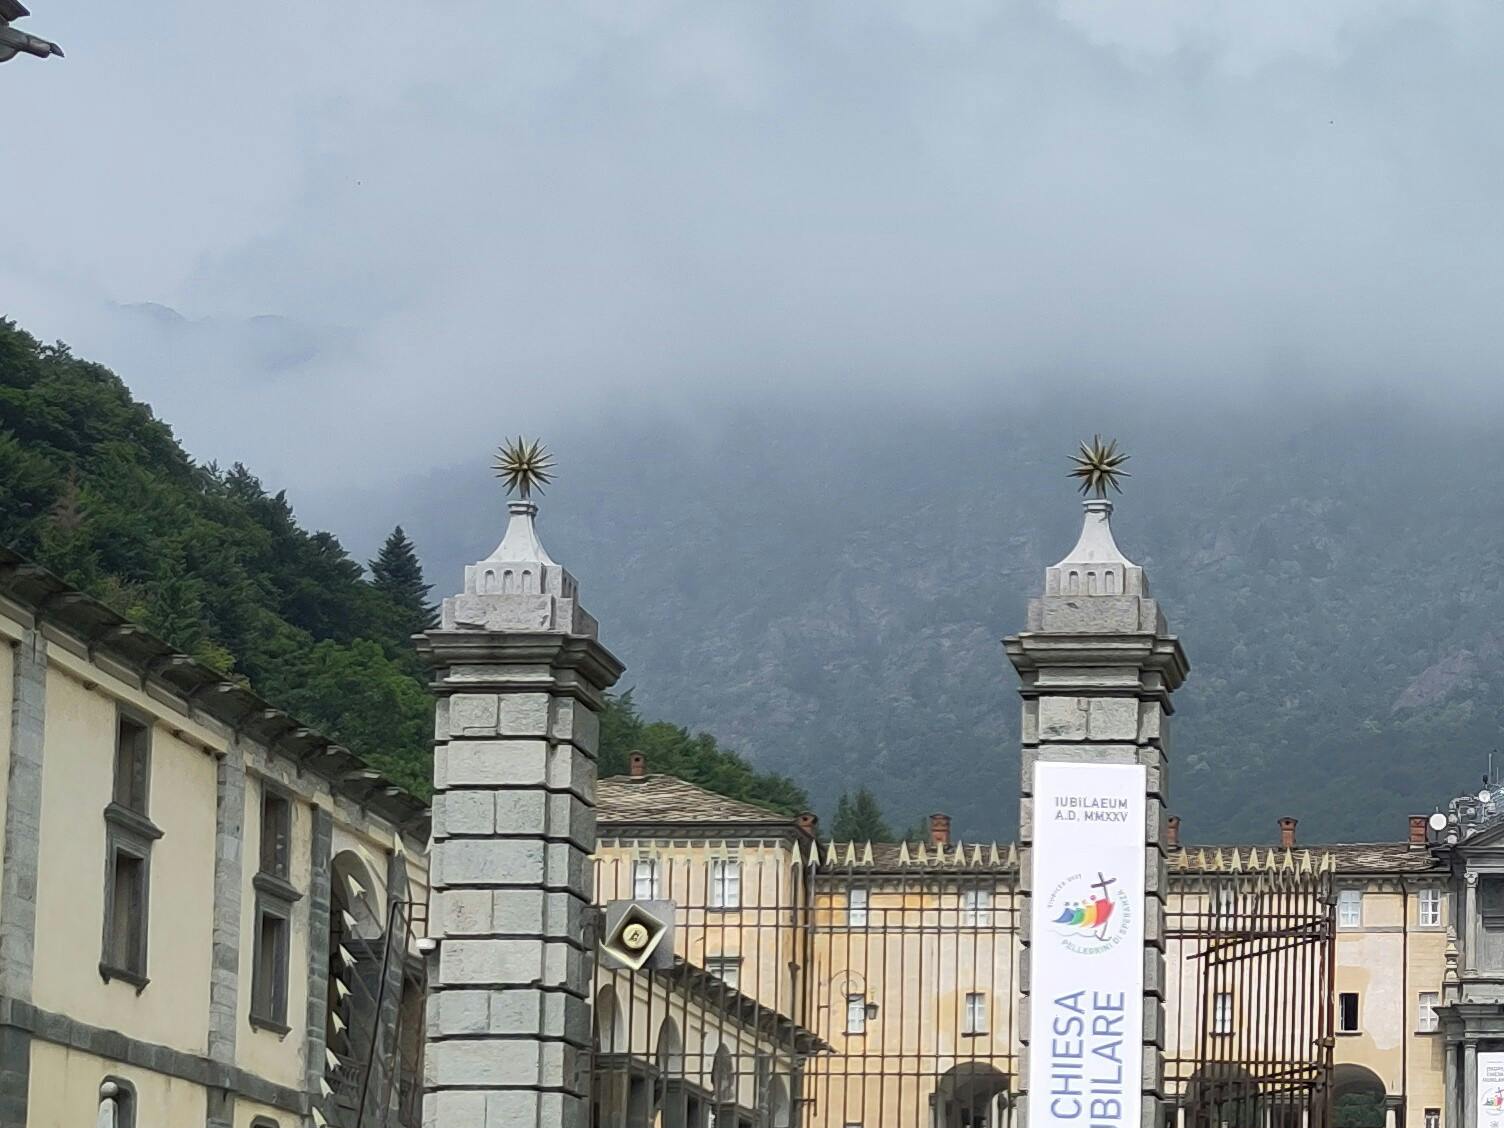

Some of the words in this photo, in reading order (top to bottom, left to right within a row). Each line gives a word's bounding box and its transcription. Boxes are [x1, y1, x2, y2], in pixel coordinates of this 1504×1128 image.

[1054, 796, 1128, 809] IUBILAEUM
[1054, 810, 1080, 822] A.D.
[1084, 811, 1129, 823] MMXXV
[1050, 989, 1086, 1119] CHIESA
